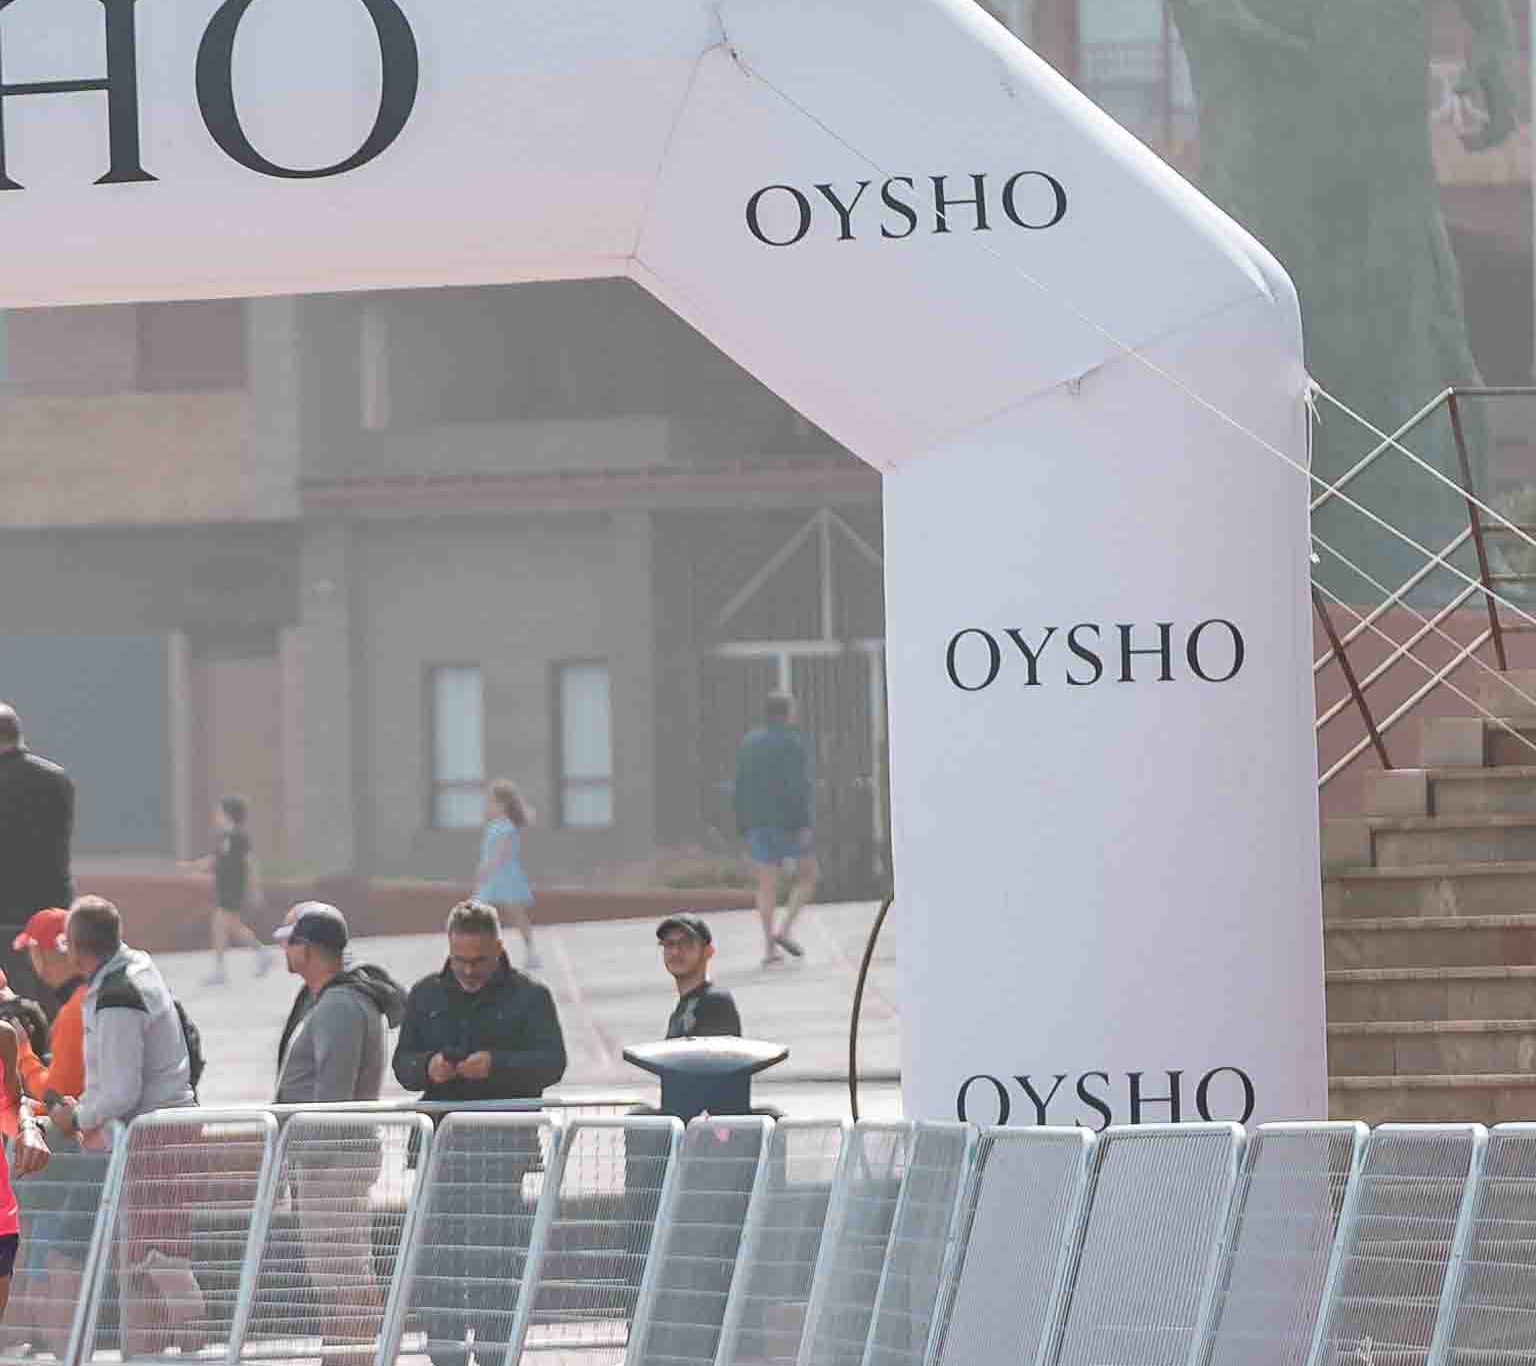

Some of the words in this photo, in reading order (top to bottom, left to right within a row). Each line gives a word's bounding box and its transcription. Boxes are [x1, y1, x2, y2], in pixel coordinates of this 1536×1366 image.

[745, 170, 1068, 246] OYSHO
[945, 617, 1247, 693] OYSHO
[956, 1066, 1256, 1133] OYSHO
